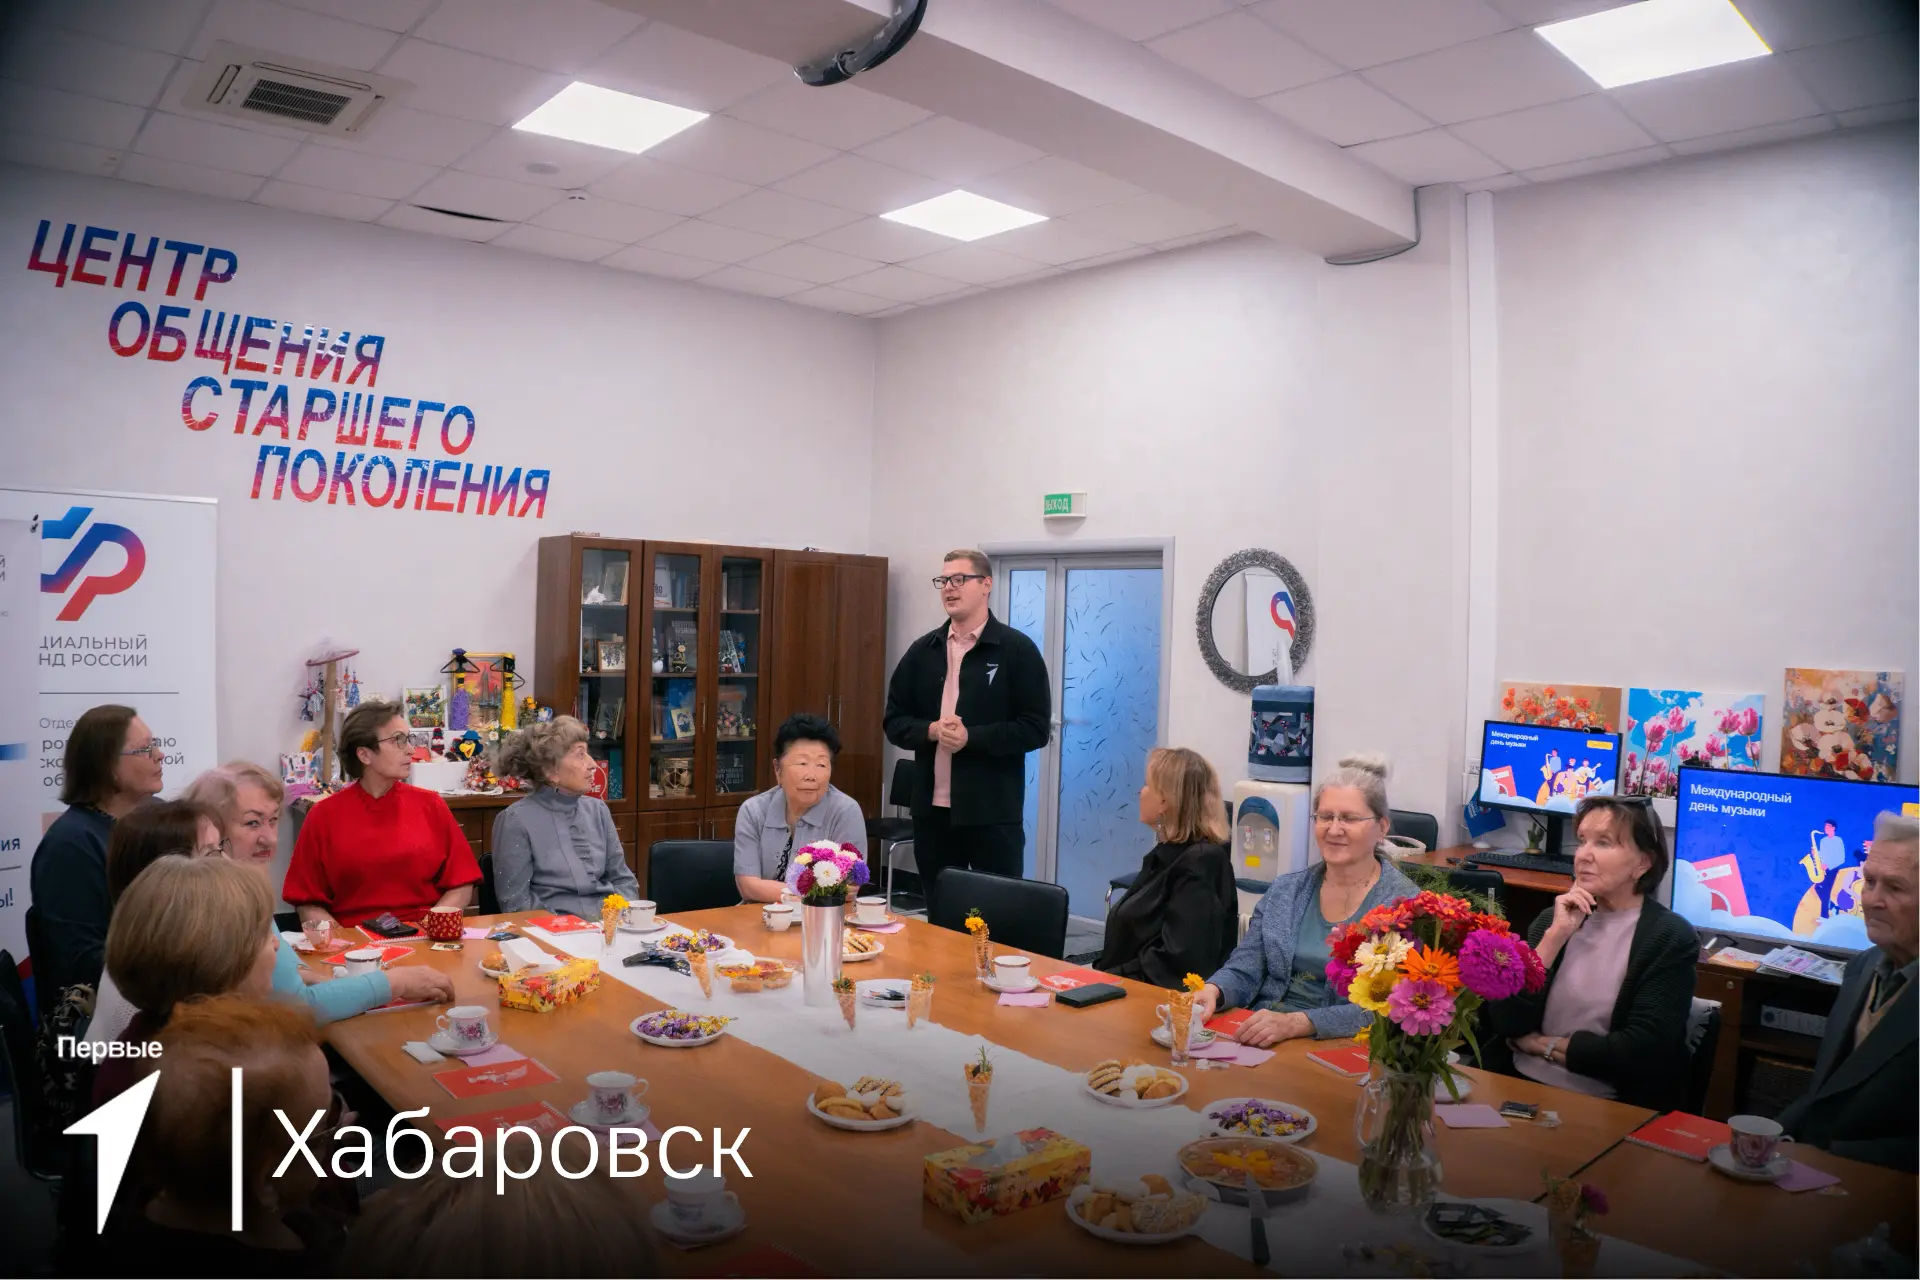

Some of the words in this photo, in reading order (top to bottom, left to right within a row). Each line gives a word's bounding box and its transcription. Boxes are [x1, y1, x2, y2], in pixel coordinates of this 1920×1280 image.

[27, 219, 238, 301] ЦЕНТР
[107, 301, 386, 388] ОБЩЕНИЯ
[181, 375, 476, 456] СТАРШЕГО
[250, 444, 551, 519] ПОКОЛЕНИЯ
[1045, 498, 1068, 512] ЫХОД
[71, 653, 148, 667] РОССИИ
[1491, 731, 1538, 741] Международный
[1689, 783, 1793, 804] Международный
[1688, 801, 1719, 813] день
[1720, 804, 1767, 818] музыки
